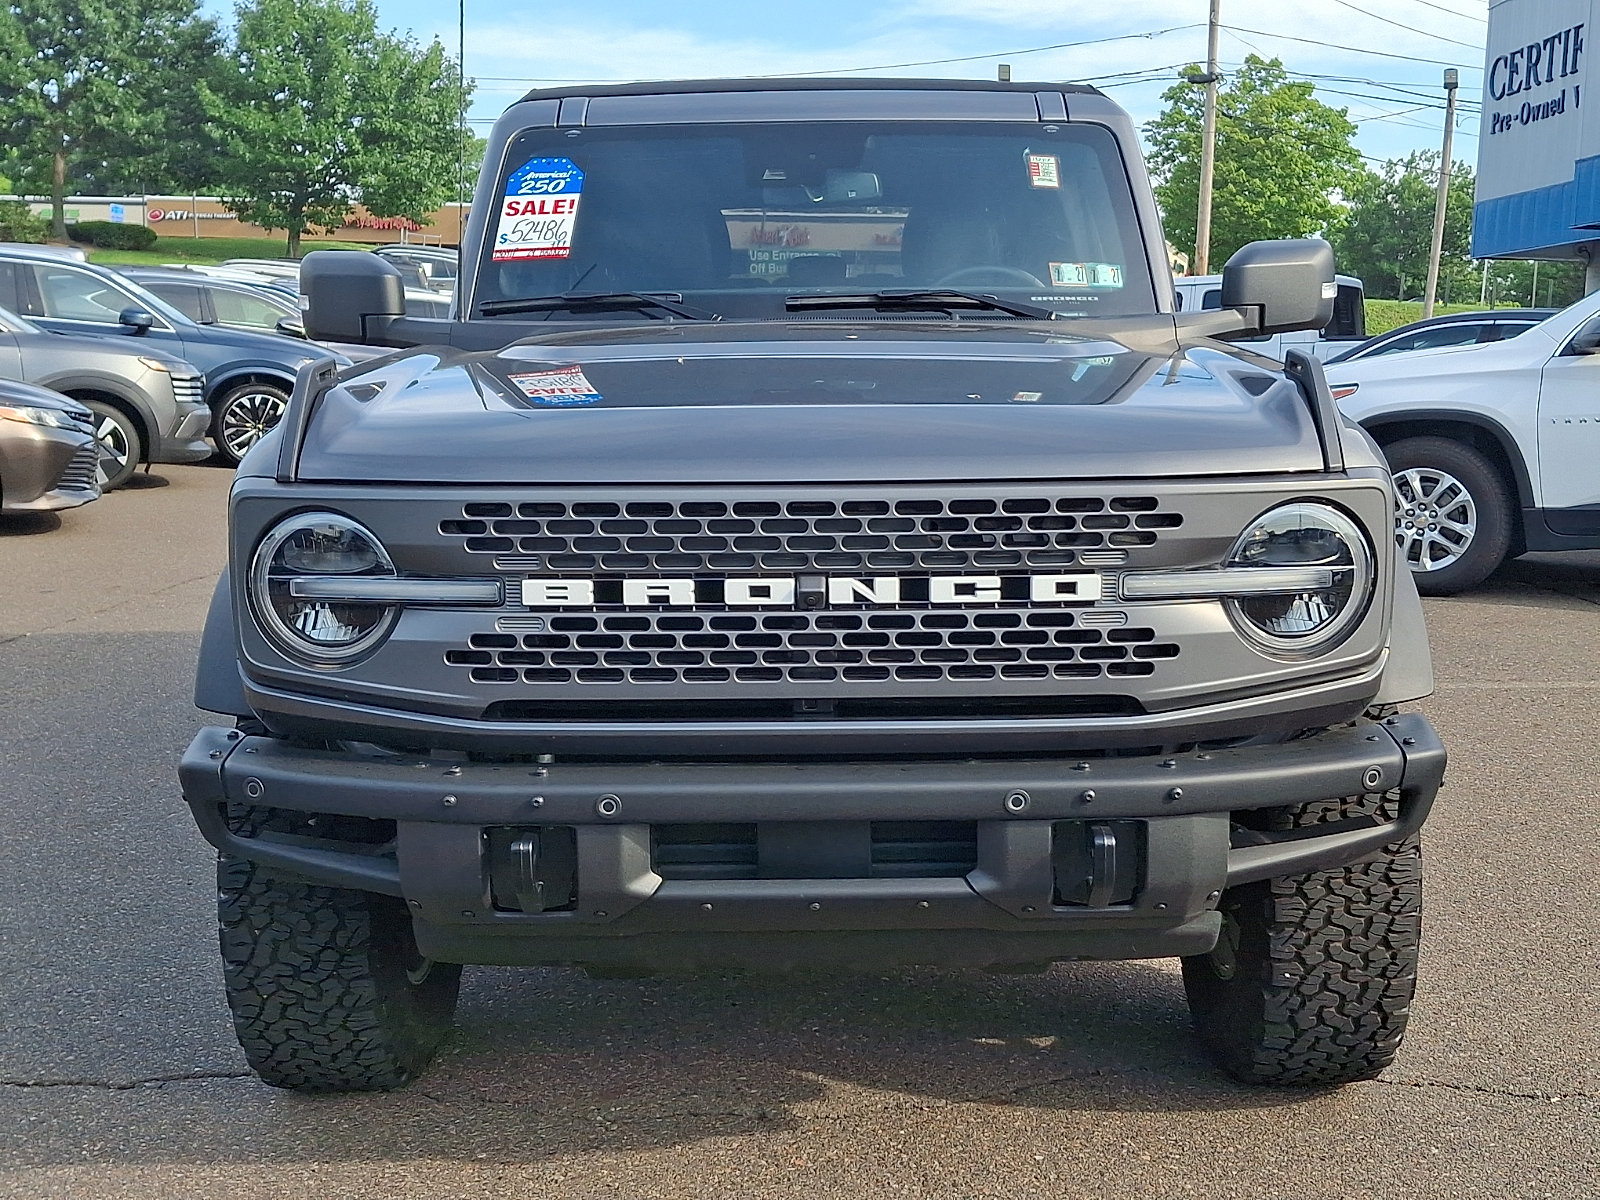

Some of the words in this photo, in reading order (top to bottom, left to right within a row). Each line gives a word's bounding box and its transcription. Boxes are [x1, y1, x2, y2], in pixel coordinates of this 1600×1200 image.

[1490, 88, 1565, 134] Pre-Owned
[518, 180, 565, 194] 250
[165, 210, 189, 220] ATI
[505, 199, 576, 217] SALE!
[748, 250, 769, 261] Use
[749, 263, 765, 274] Off
[521, 573, 1102, 607] BRONCO
